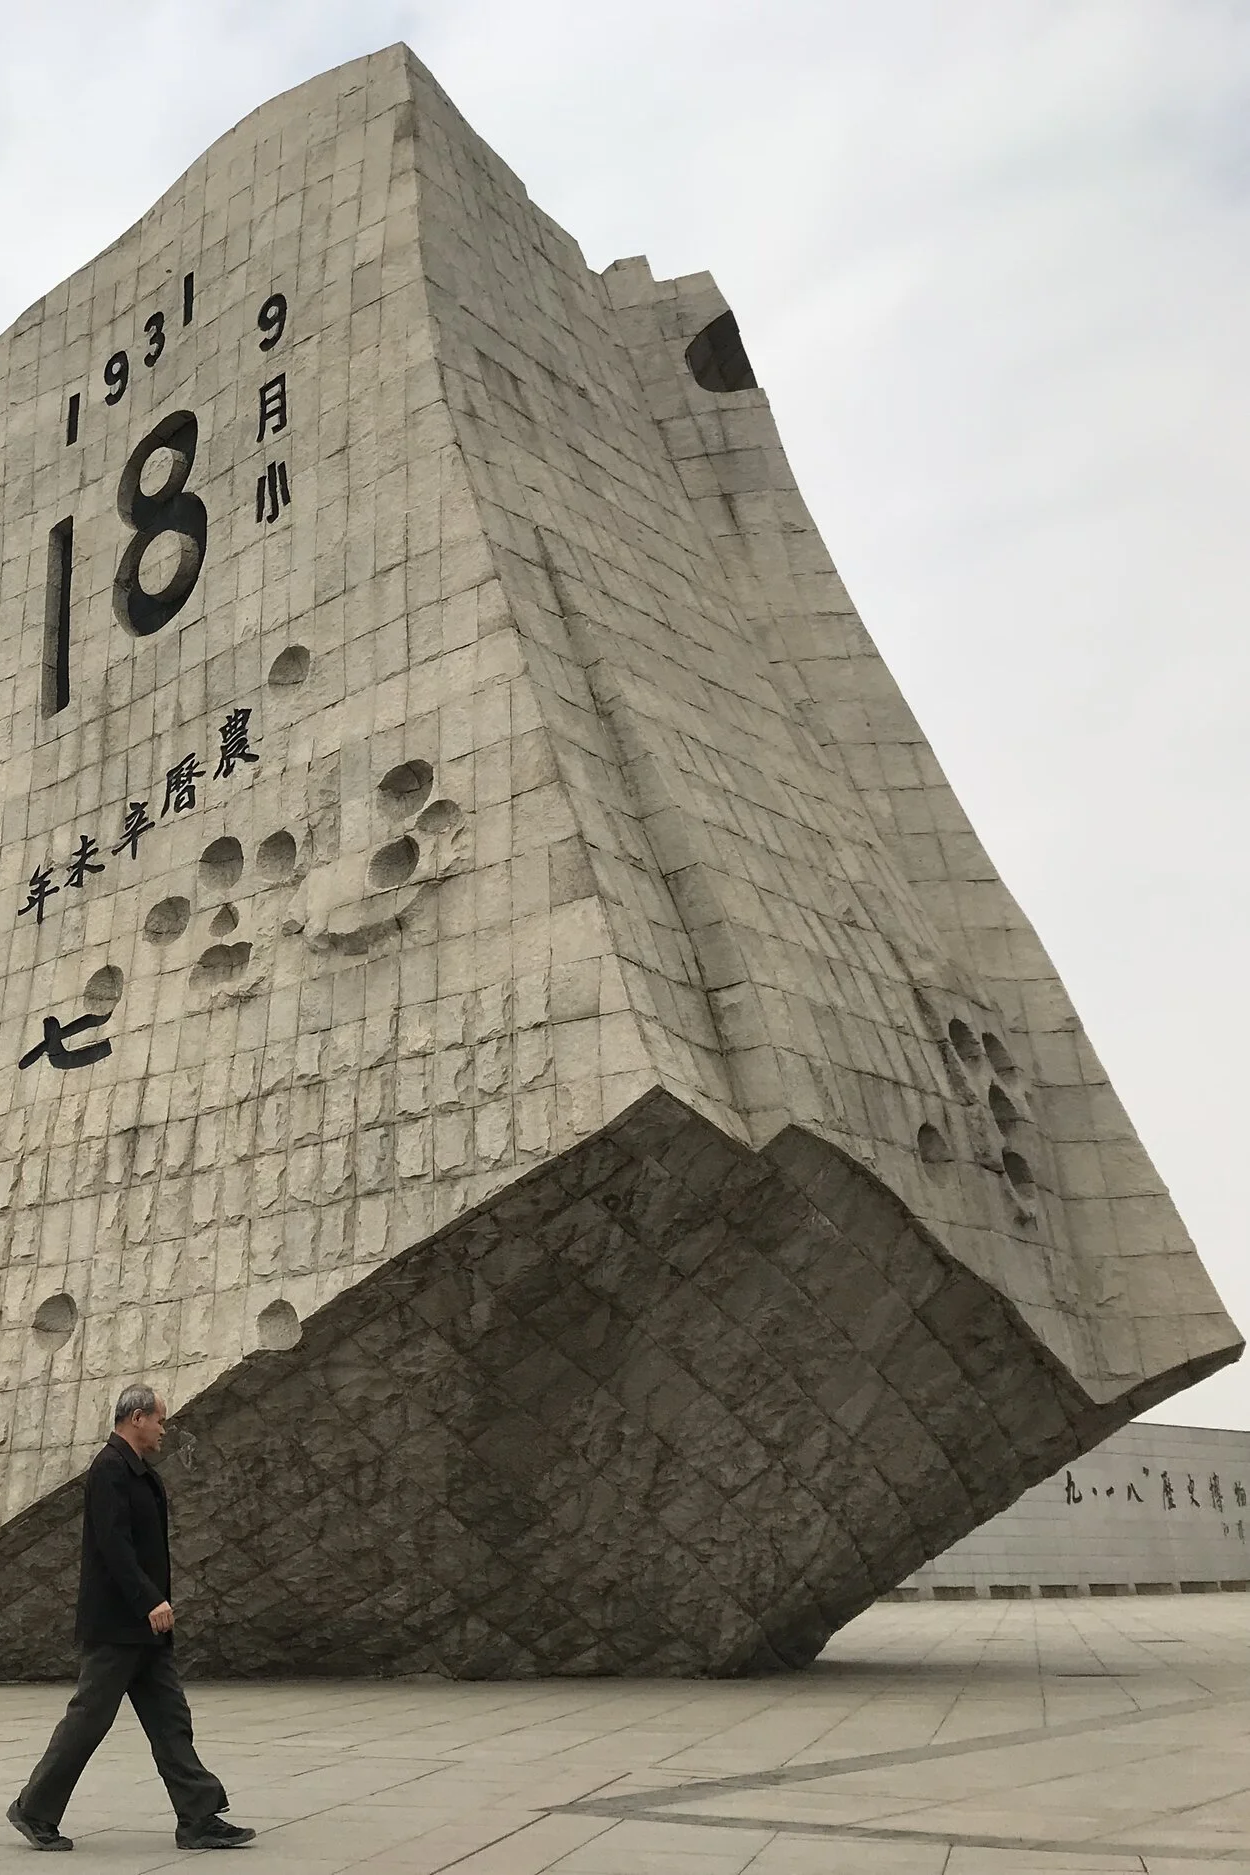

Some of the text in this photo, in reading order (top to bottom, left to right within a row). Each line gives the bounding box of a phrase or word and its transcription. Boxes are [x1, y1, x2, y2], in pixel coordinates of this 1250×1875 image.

[66, 271, 195, 446] 1931
[41, 409, 208, 720] 18
[18, 1010, 113, 1071] 七
